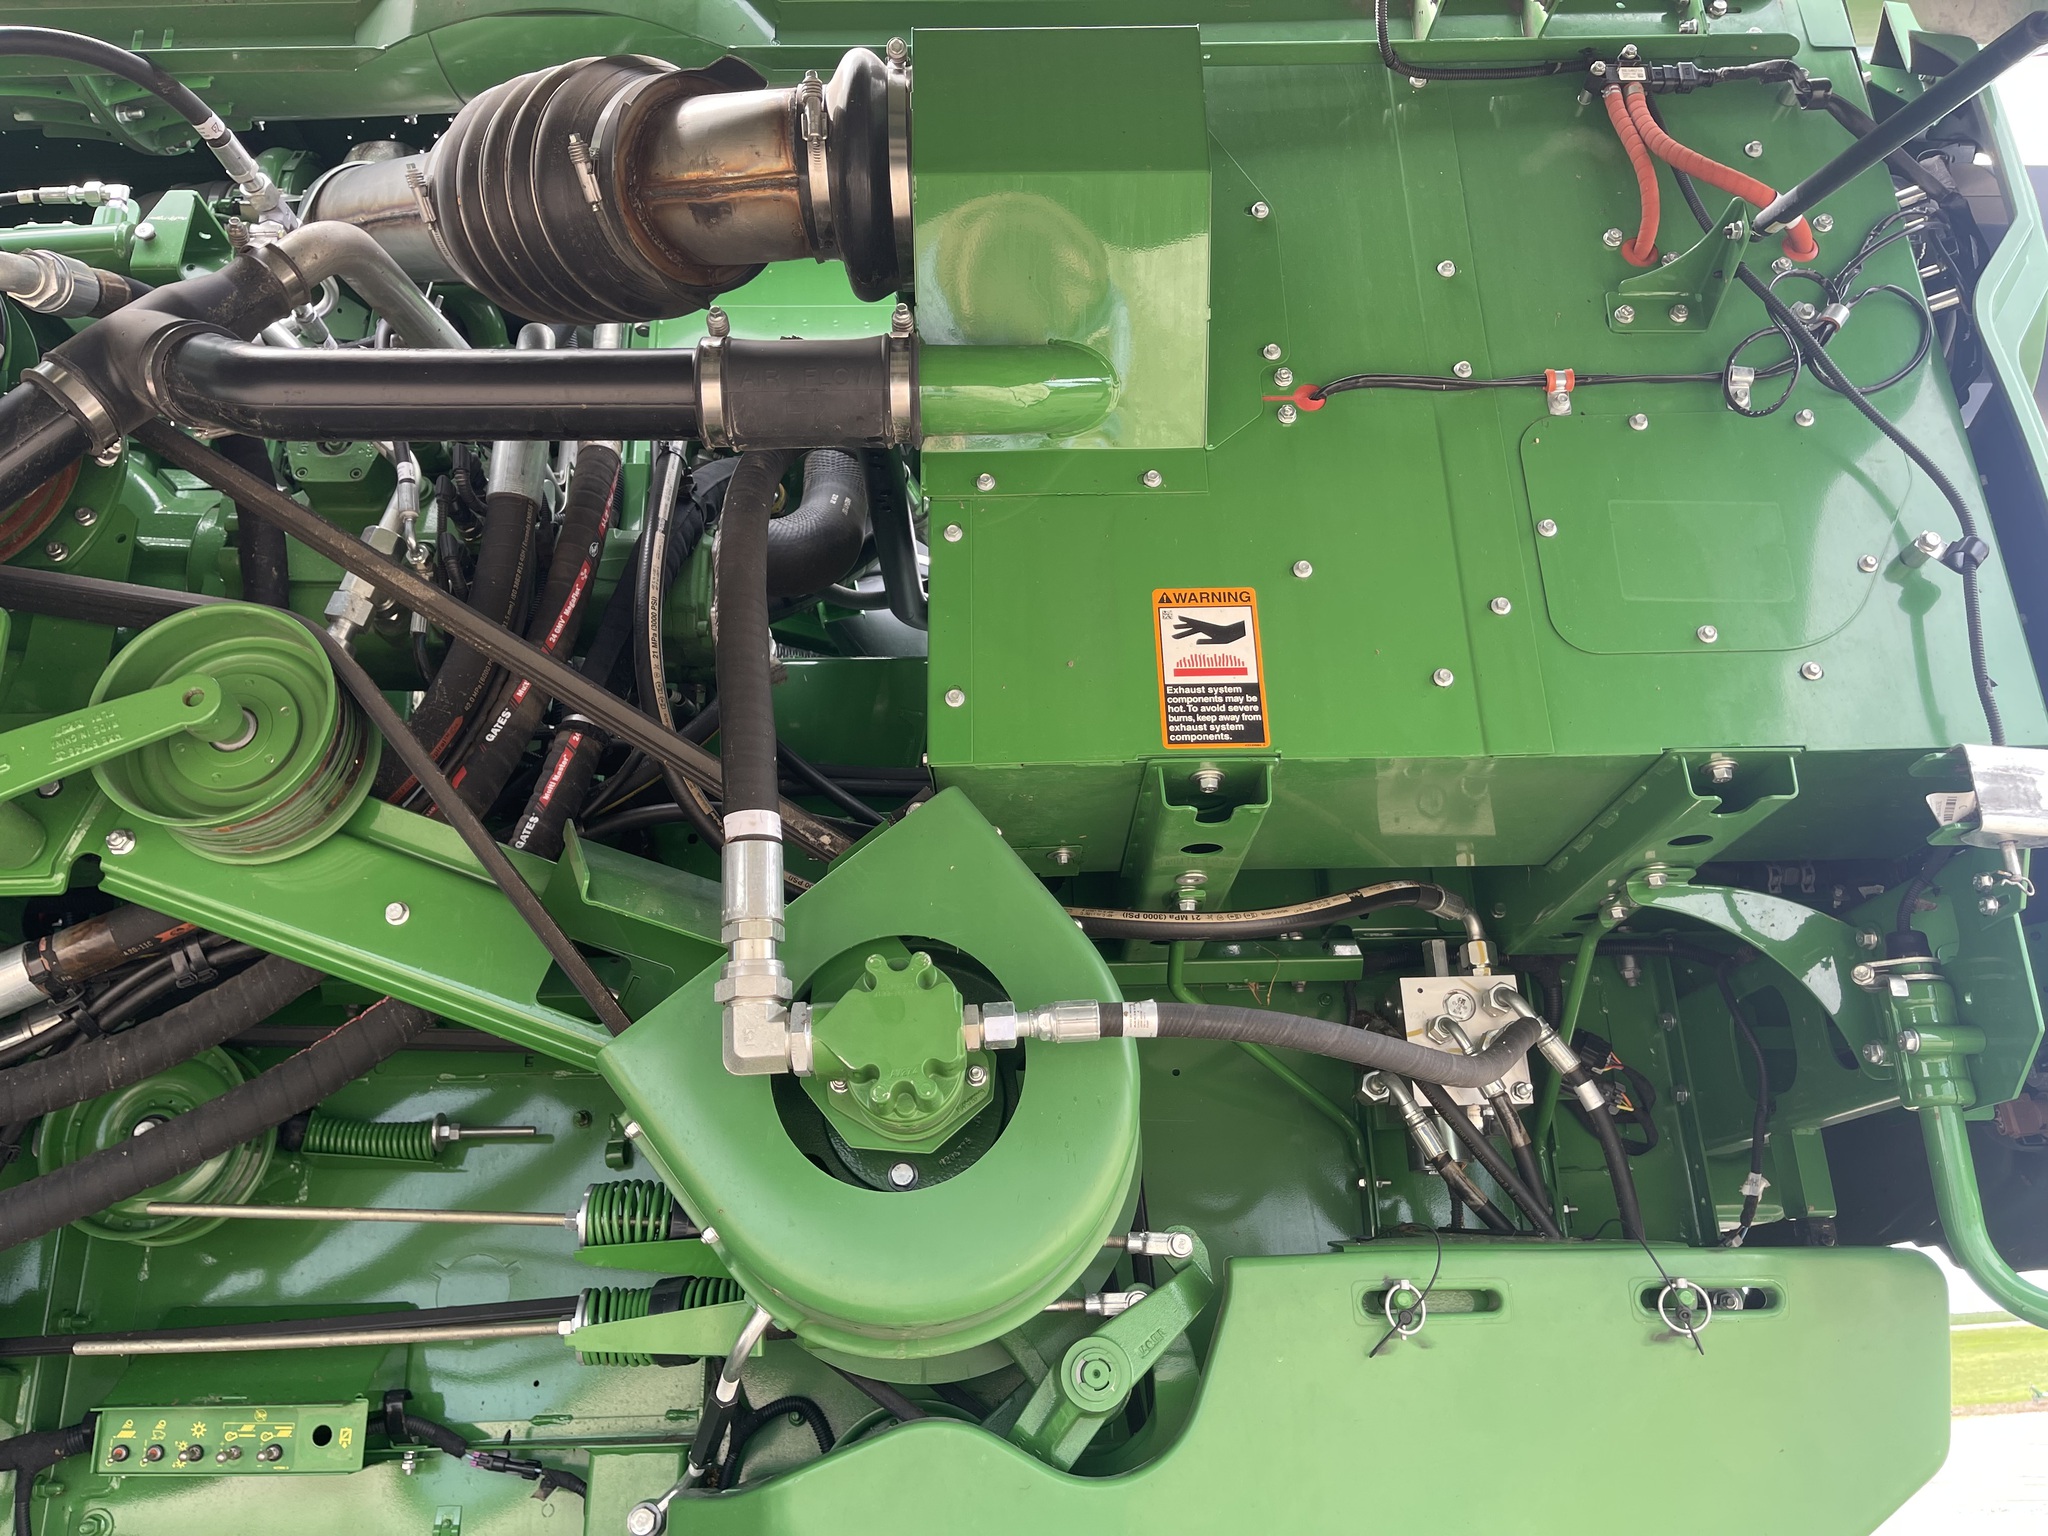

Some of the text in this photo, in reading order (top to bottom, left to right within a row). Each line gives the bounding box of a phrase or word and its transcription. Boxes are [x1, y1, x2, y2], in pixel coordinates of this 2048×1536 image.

[1172, 591, 1251, 603] WARNING
[548, 632, 559, 644] 24
[652, 650, 659, 659] 21
[1208, 686, 1242, 695] system
[1167, 696, 1223, 704] components
[1225, 696, 1244, 704] may
[1168, 705, 1185, 713] hot.
[1187, 704, 1199, 712] To
[1201, 704, 1226, 712] avoid
[1197, 714, 1216, 723] keep
[1210, 723, 1245, 732] system
[1170, 733, 1233, 742] components.
[540, 780, 558, 802] Multi
[1190, 912, 1201, 921] 21
